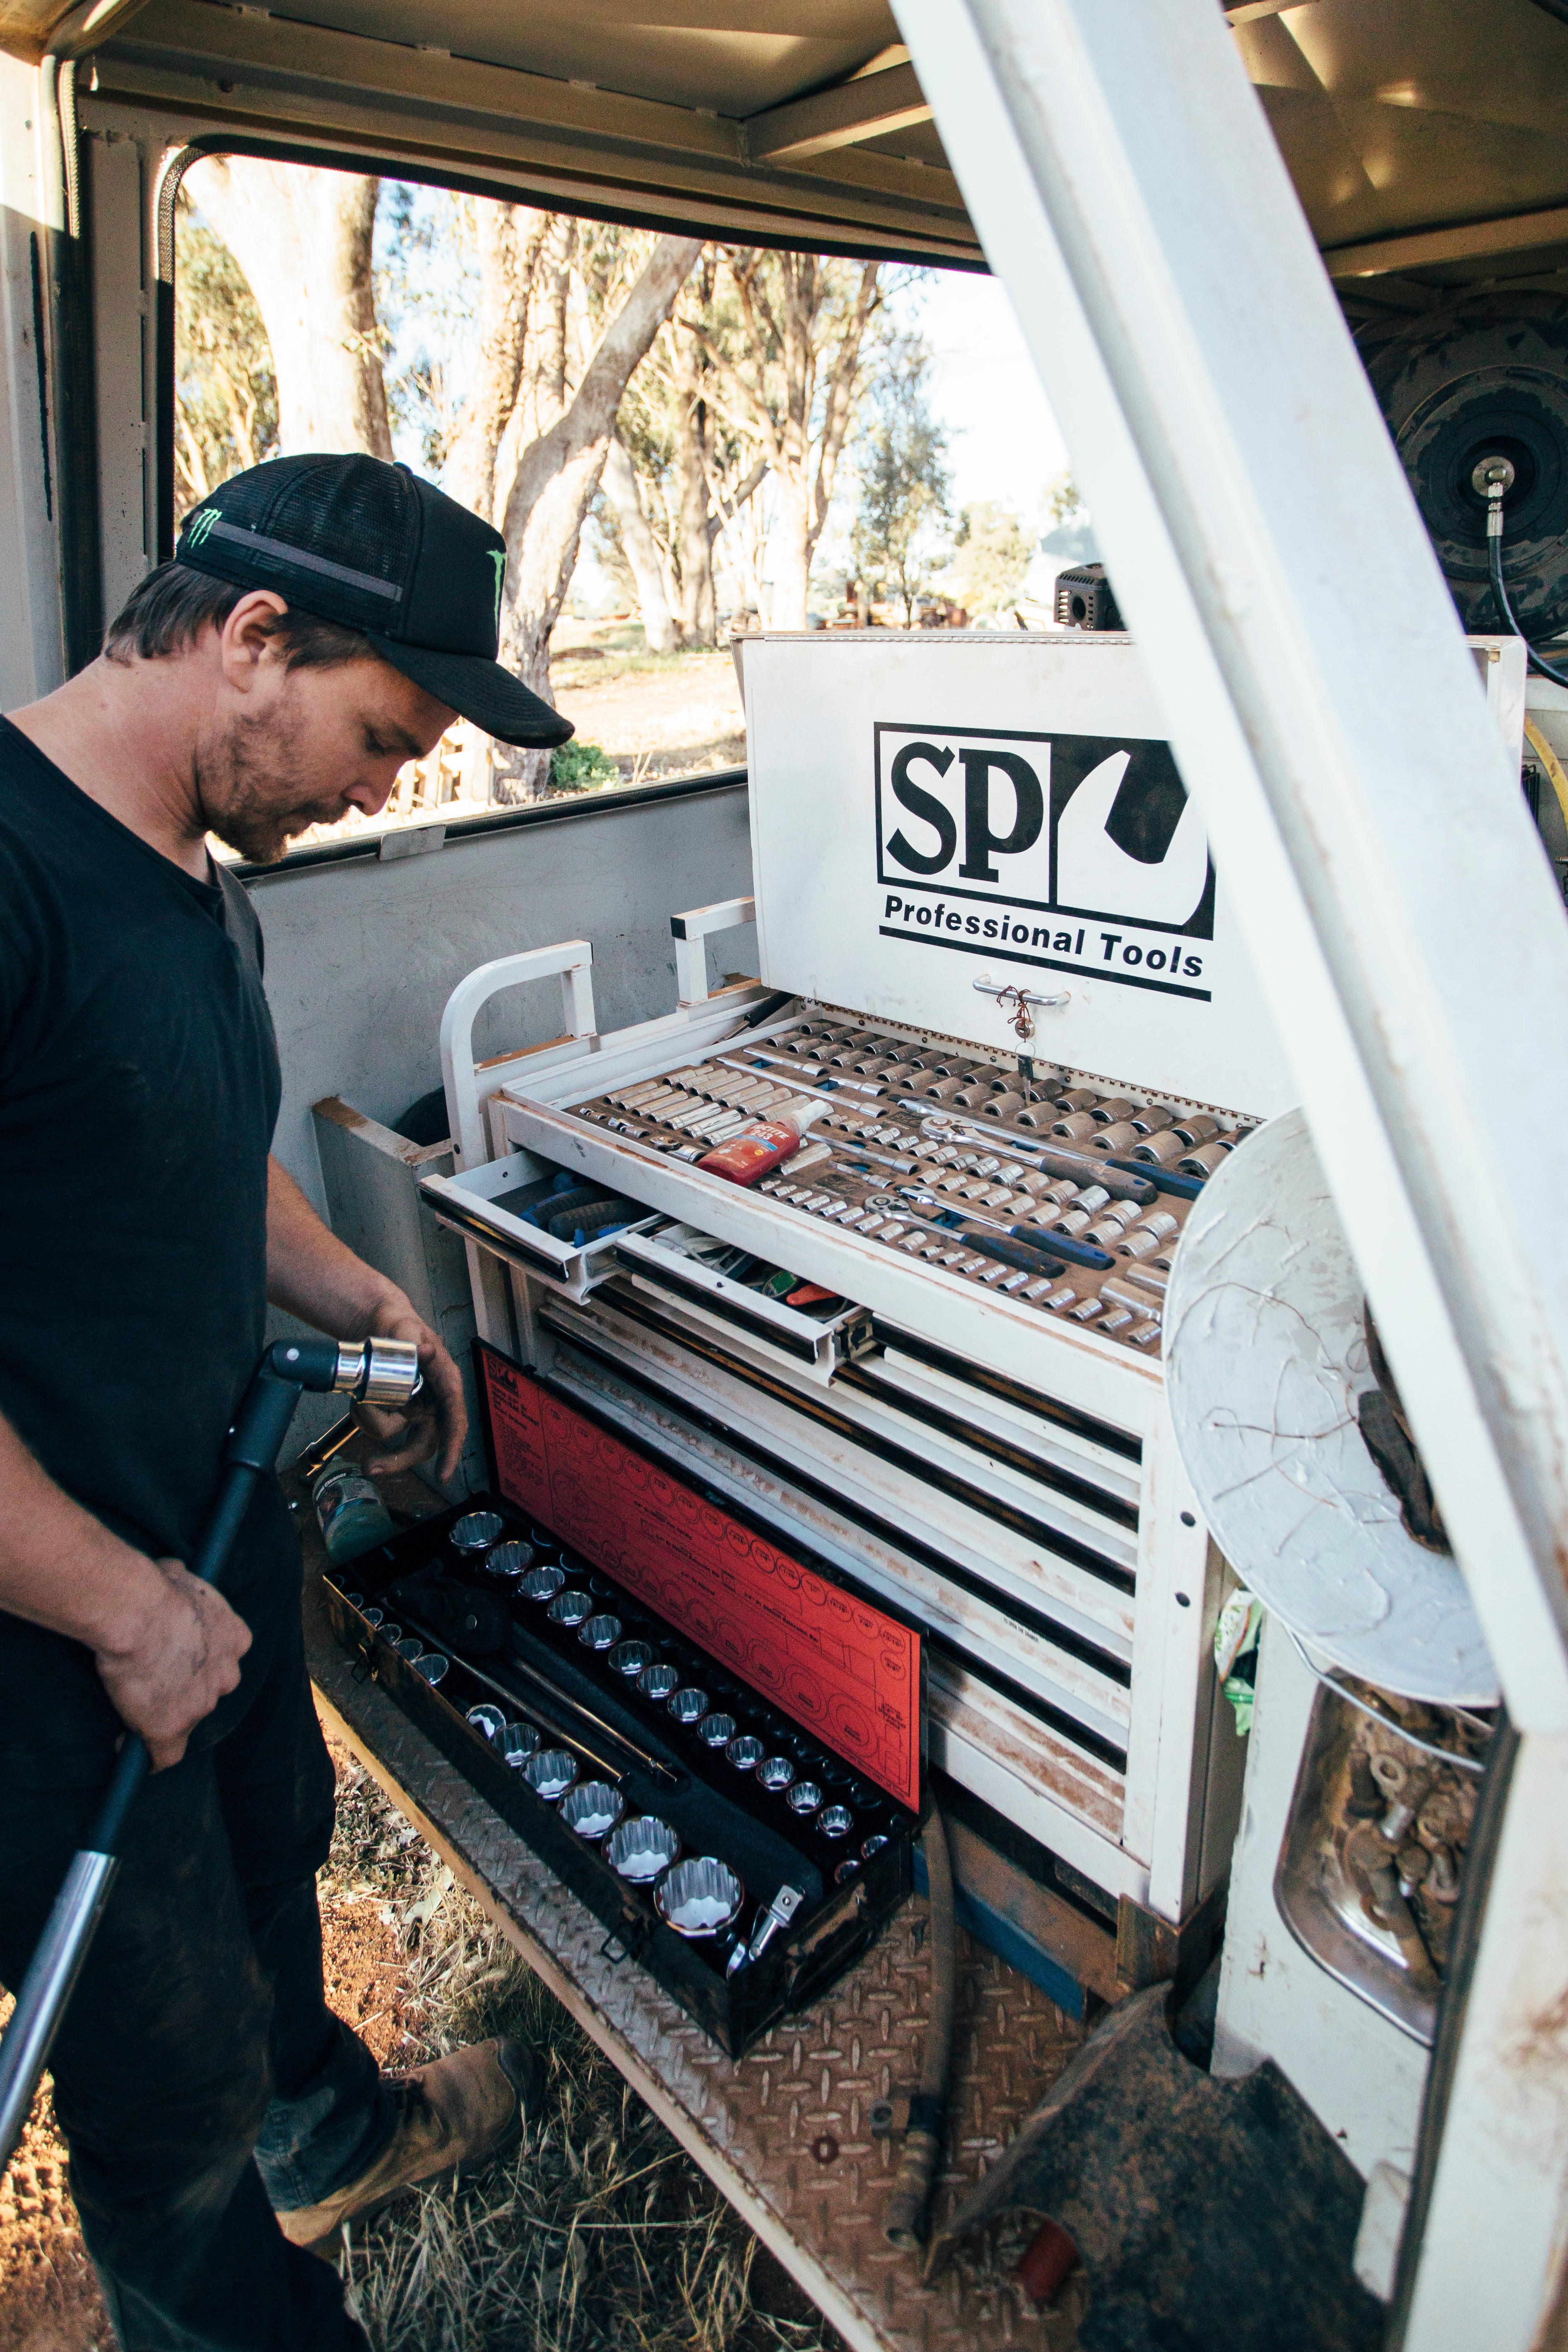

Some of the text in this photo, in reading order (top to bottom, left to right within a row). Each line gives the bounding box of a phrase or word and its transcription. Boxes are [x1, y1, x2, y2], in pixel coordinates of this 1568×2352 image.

[886, 741, 1044, 883] SP
[885, 895, 1203, 977] Professional Tools
[750, 1124, 790, 1140] LOCTITE
[750, 1129, 773, 1140] 243
